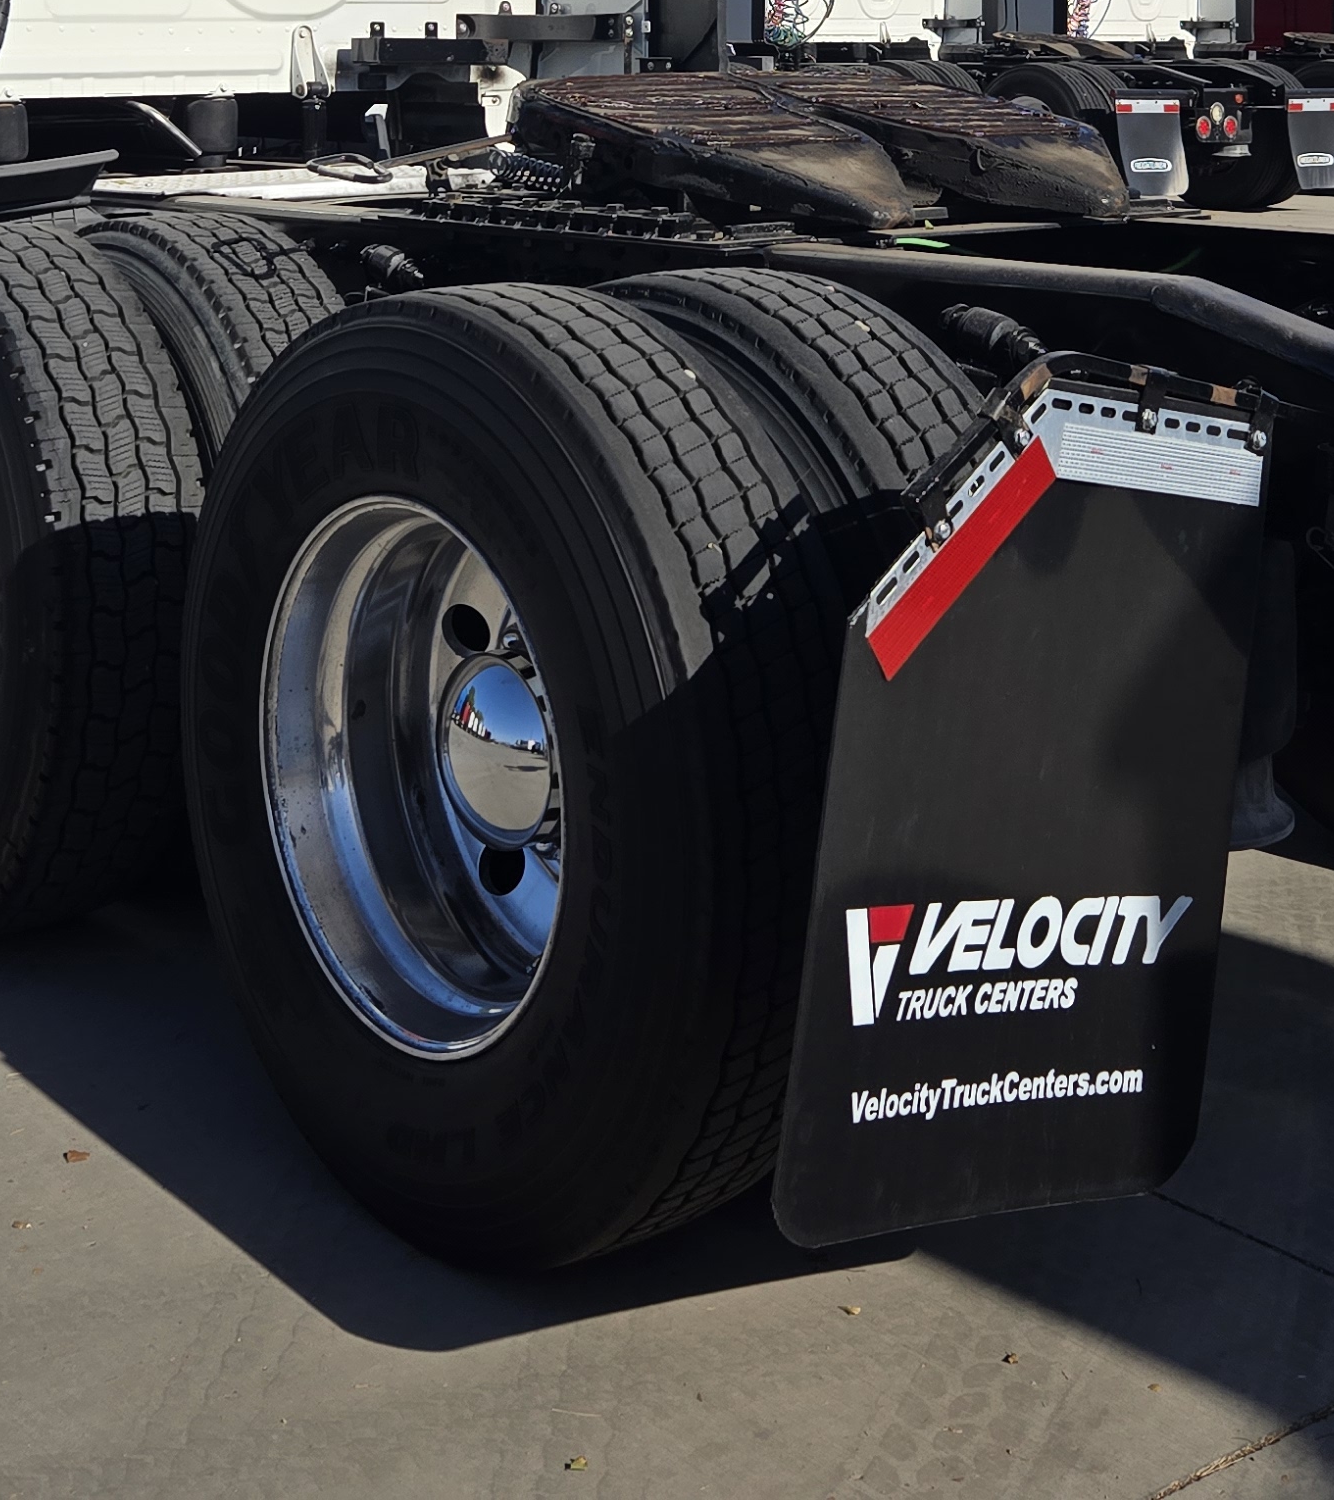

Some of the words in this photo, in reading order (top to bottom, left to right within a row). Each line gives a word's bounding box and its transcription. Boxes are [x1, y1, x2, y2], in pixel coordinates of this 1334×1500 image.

[908, 895, 1193, 976] VELOCITY
[896, 983, 974, 1022] TRUCK
[973, 977, 1079, 1016] CENTERS
[851, 1068, 1144, 1124] VelocityTruckCenters.com
